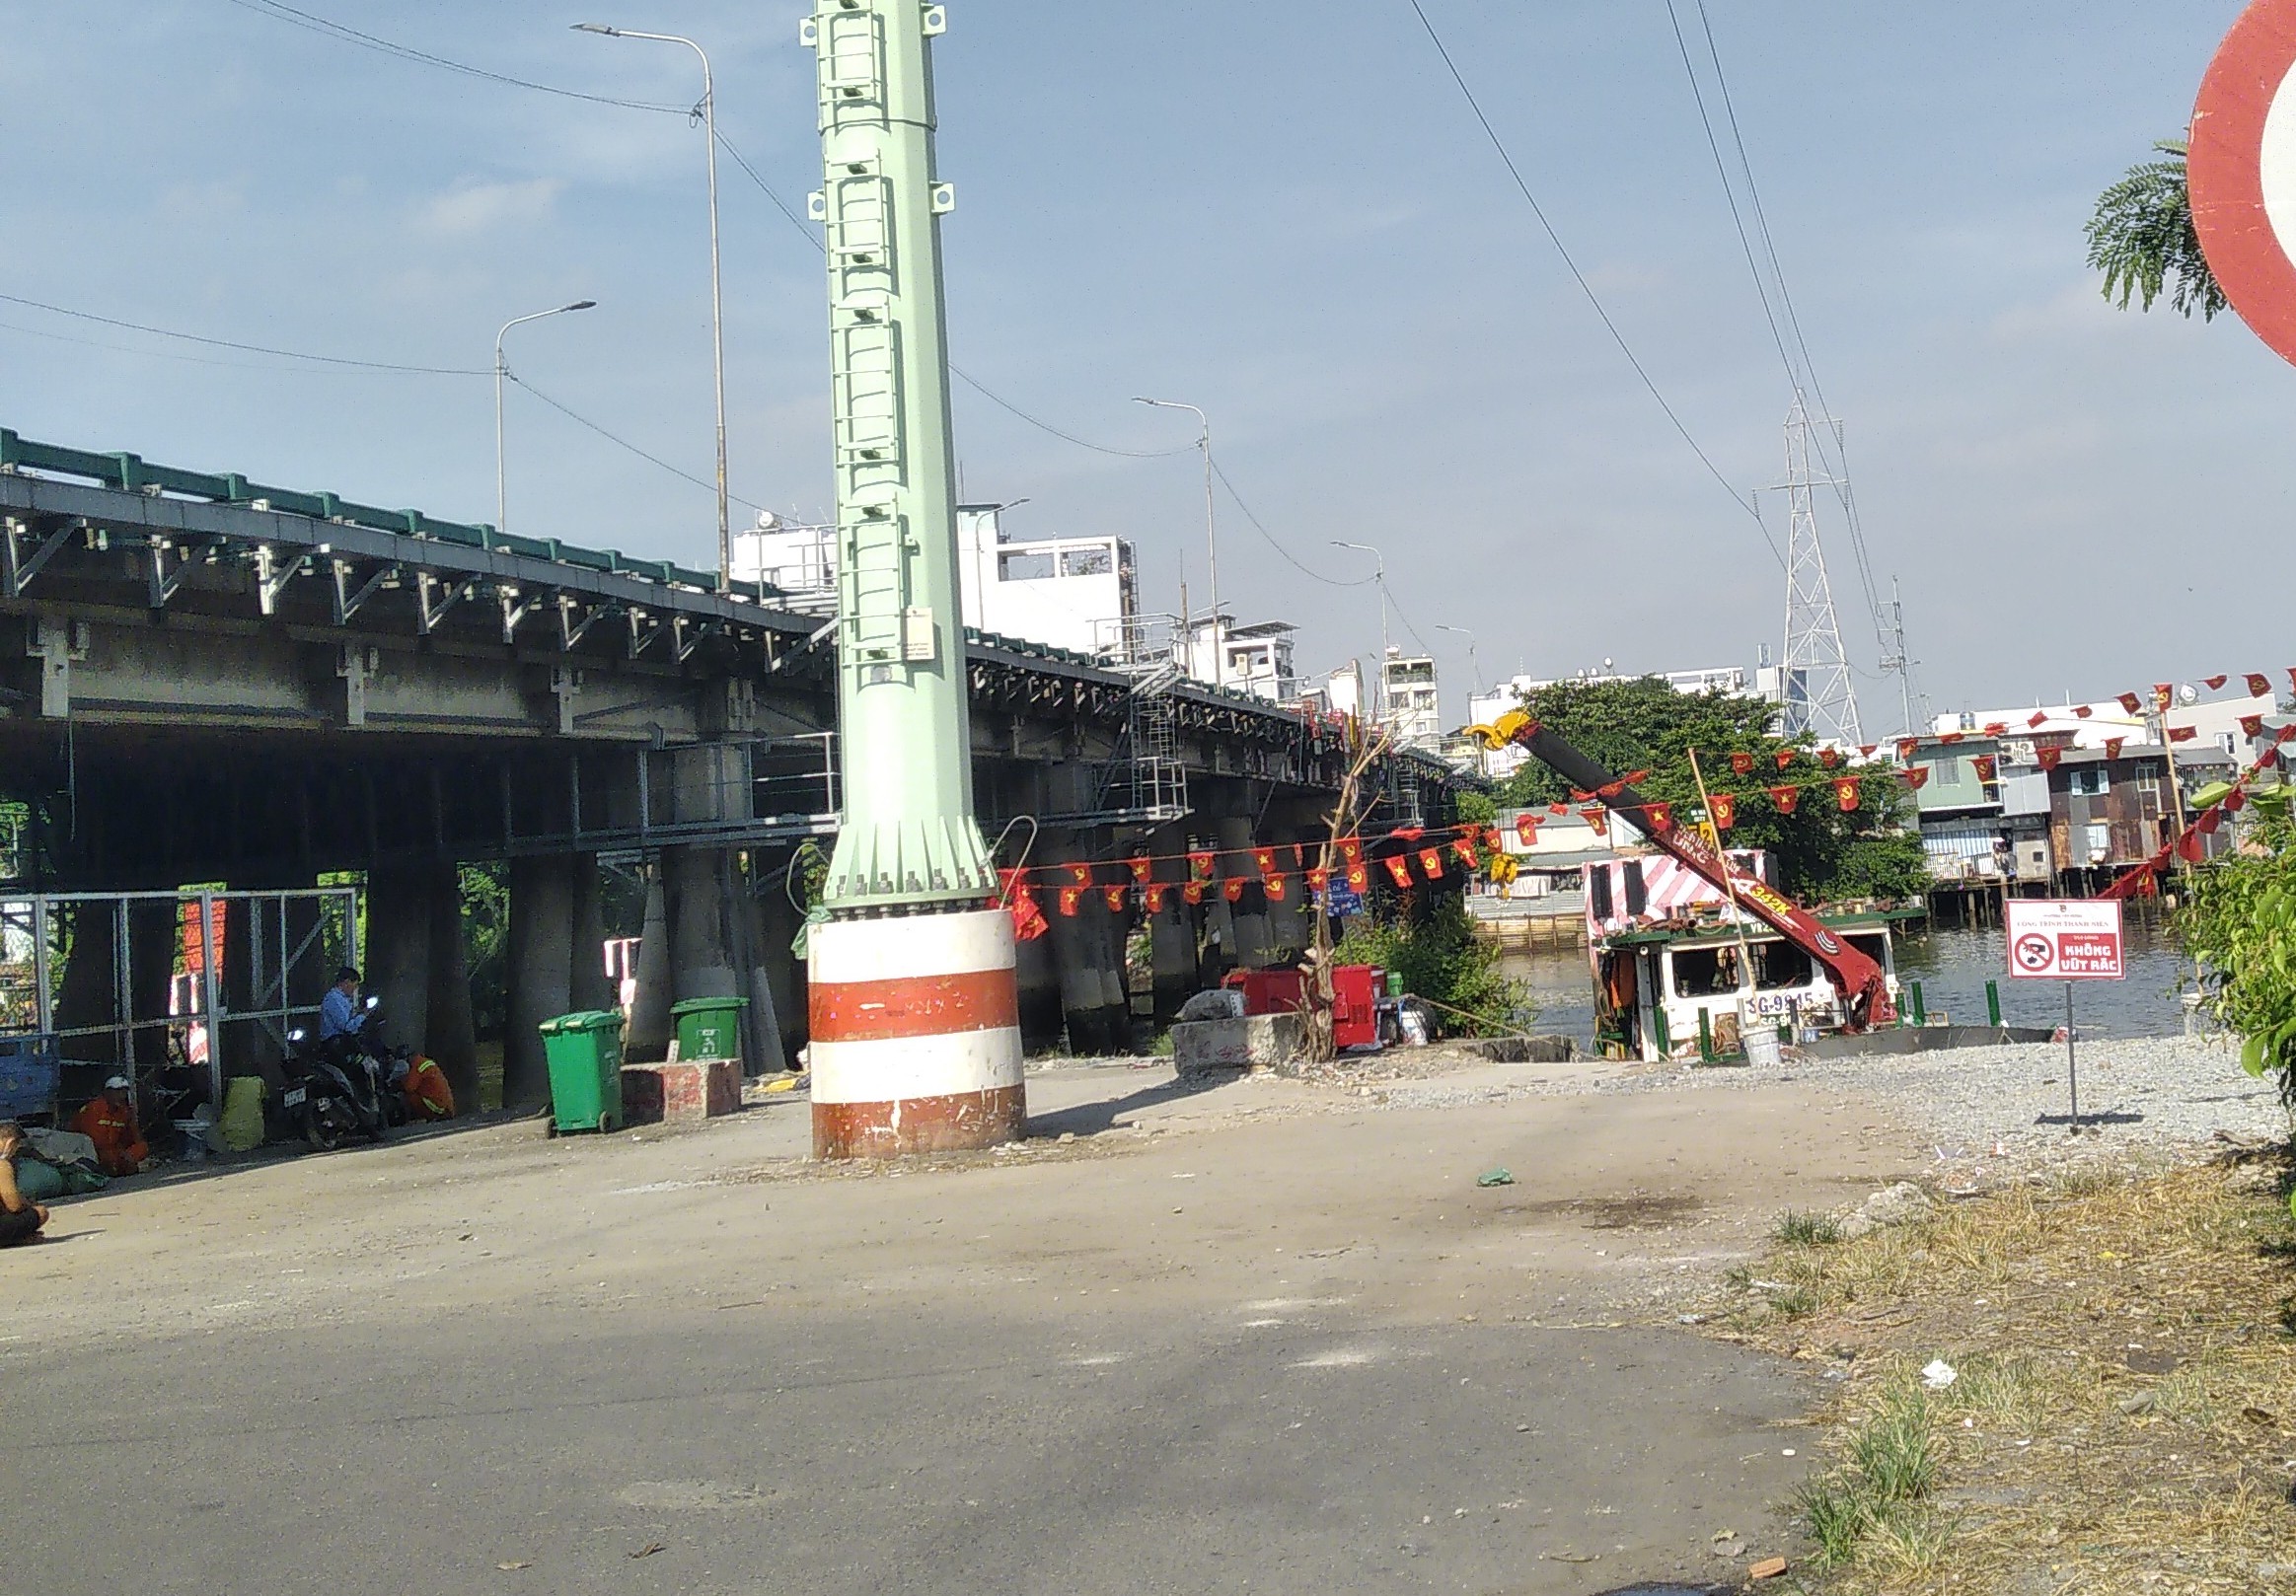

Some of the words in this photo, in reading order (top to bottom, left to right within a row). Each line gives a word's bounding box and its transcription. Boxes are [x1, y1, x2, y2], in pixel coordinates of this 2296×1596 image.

[1751, 886, 1792, 916] 342K
[2064, 942, 2111, 957] KHÔNG
[2060, 957, 2089, 971] VỨT
[2090, 957, 2117, 971] RÁC
